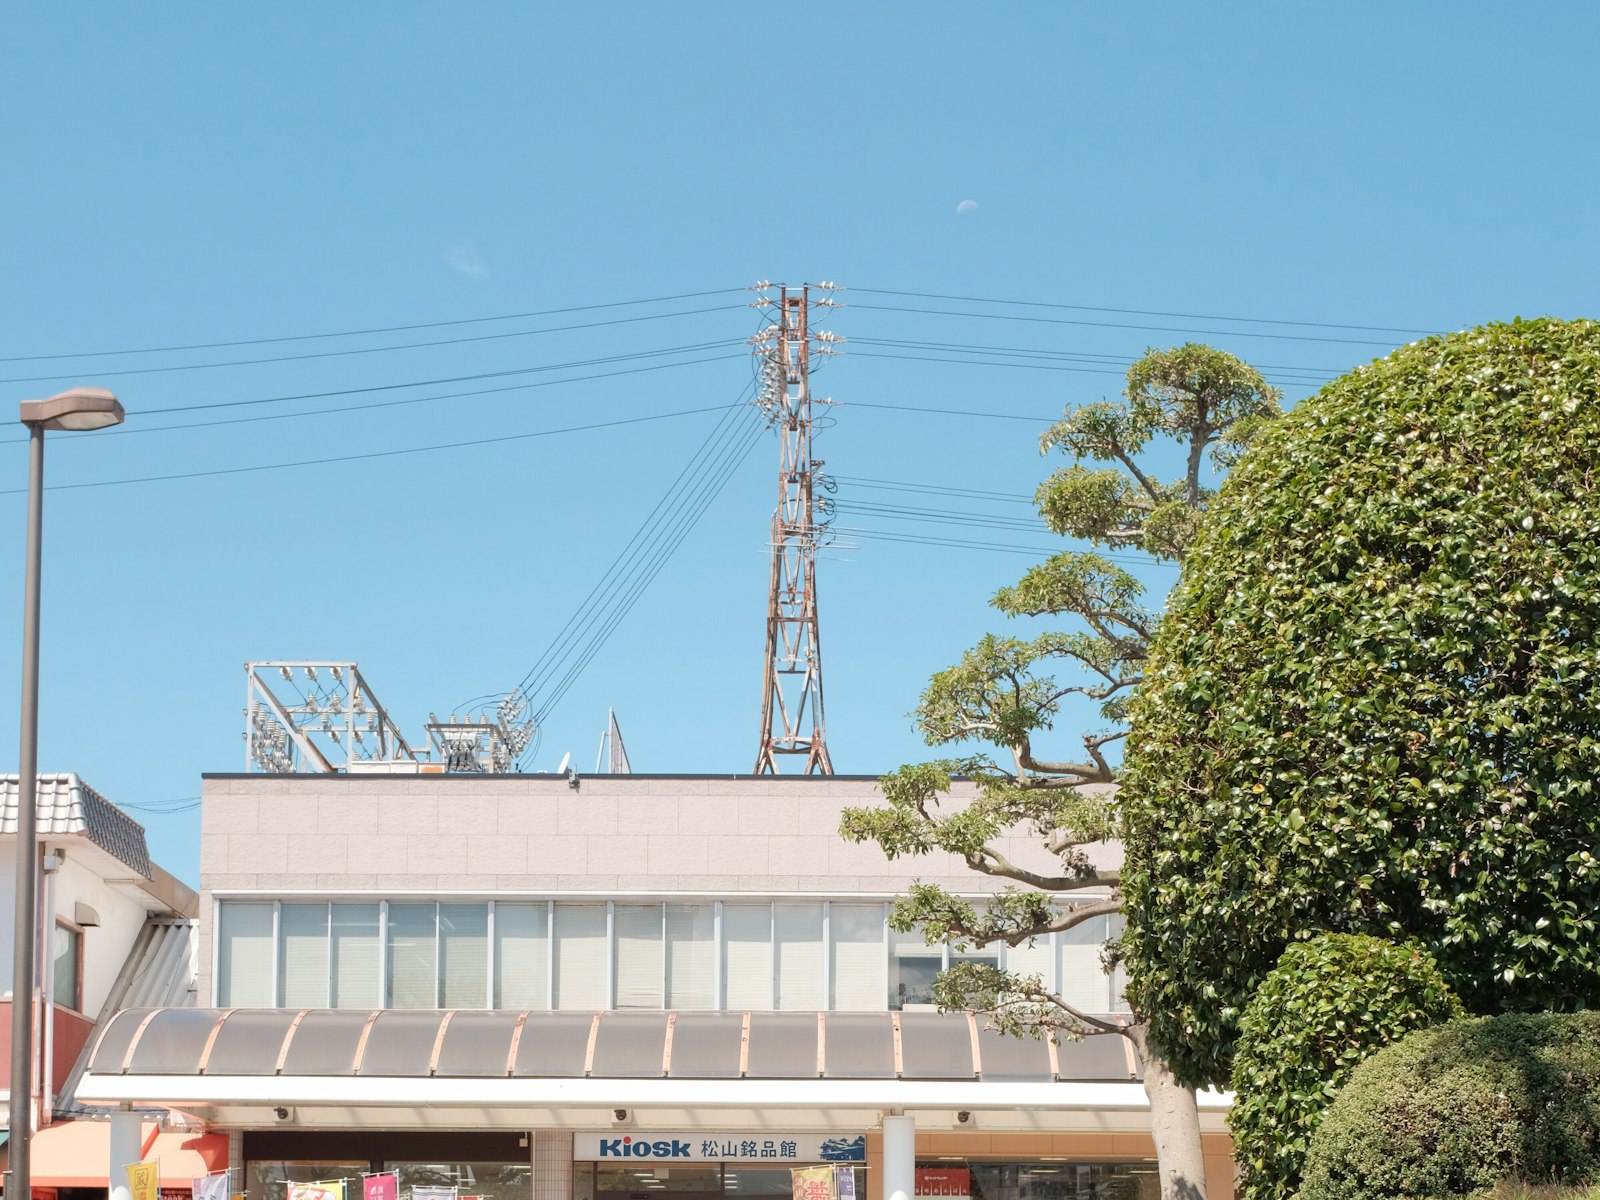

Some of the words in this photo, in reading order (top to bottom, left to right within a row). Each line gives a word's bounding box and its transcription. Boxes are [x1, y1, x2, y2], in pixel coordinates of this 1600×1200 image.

[600, 1136, 691, 1158] Kiosk
[701, 1140, 797, 1159] 松山銘品館
